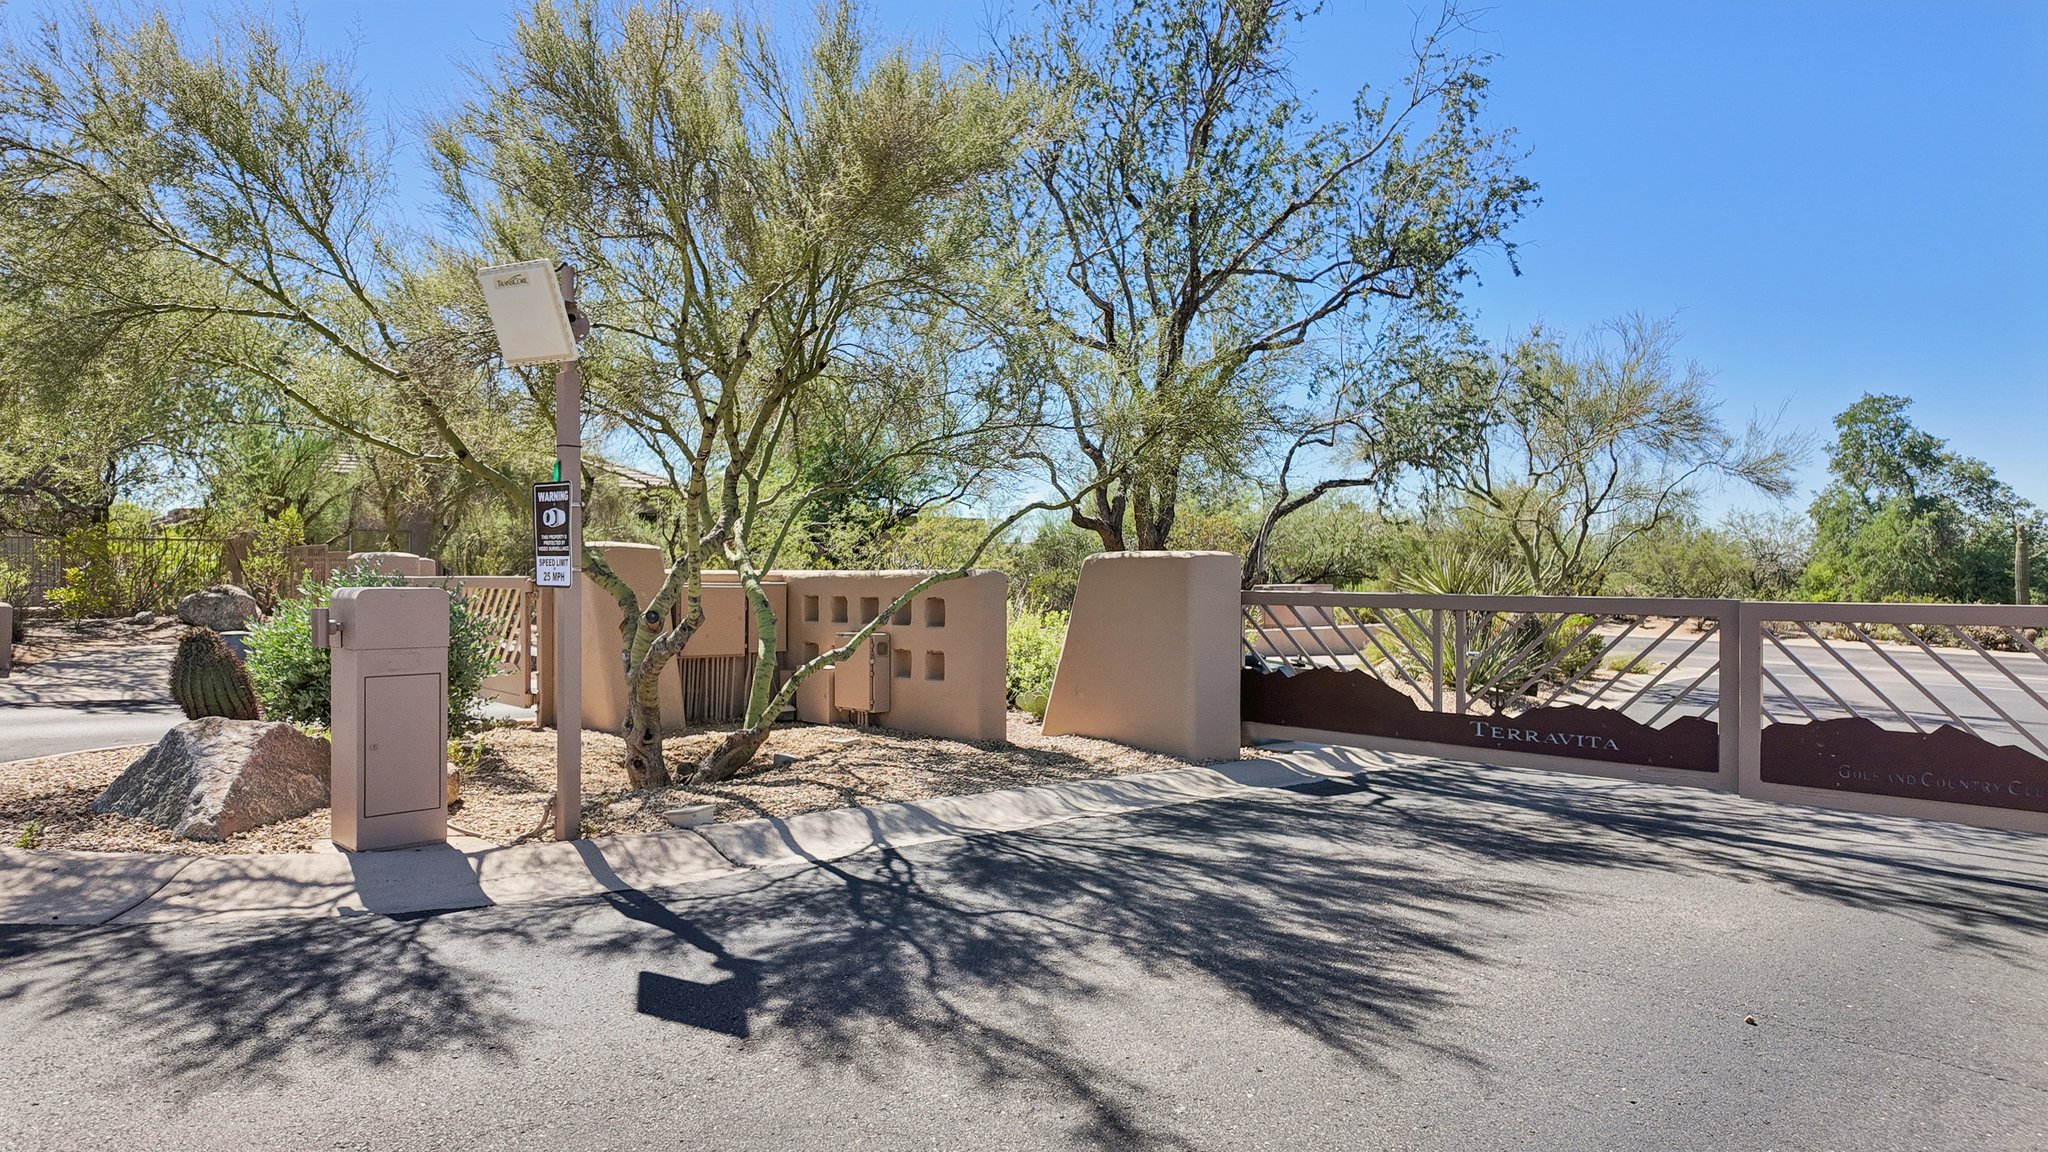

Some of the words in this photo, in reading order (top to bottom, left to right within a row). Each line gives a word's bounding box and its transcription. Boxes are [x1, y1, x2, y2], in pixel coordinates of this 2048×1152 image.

[537, 490, 569, 502] WARNING
[539, 559, 555, 567] SPEED
[556, 559, 569, 567] LIMIT
[543, 572, 551, 581] 25
[552, 572, 565, 582] MPH
[1469, 720, 1619, 750] TERRAVITA
[1838, 763, 1880, 781] GOLF
[1920, 771, 2001, 792] COUNTRY
[2008, 780, 2048, 798] CLU
